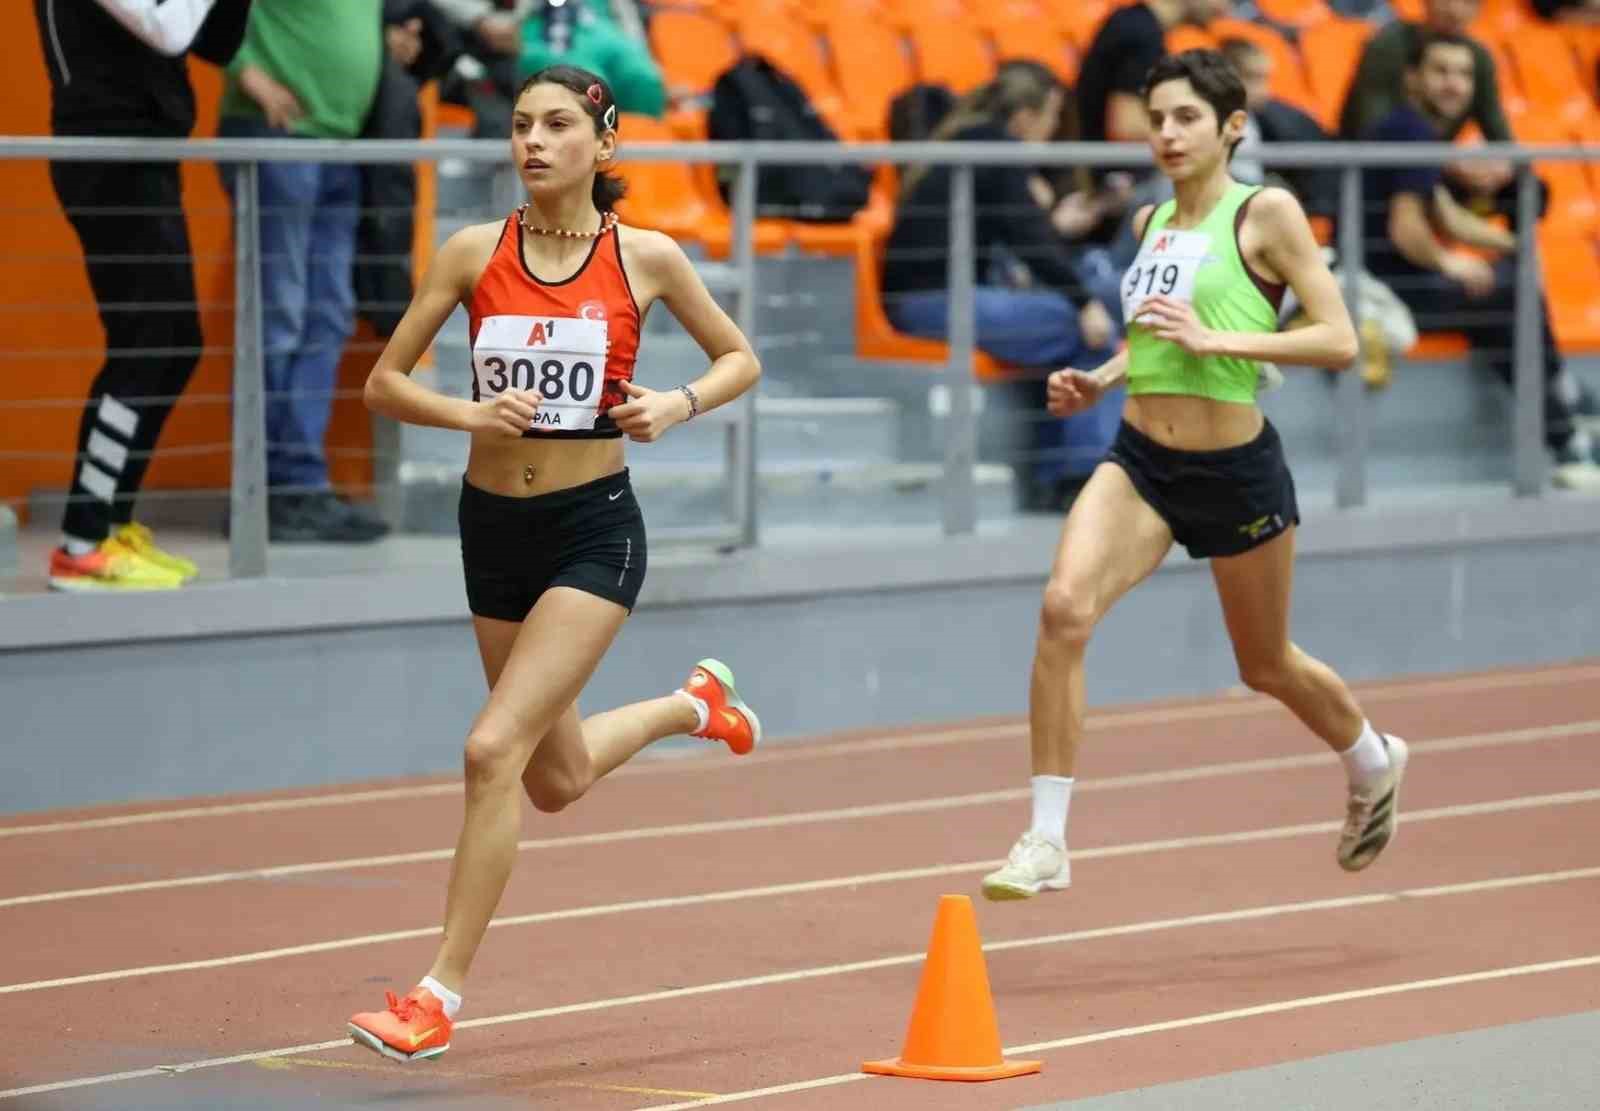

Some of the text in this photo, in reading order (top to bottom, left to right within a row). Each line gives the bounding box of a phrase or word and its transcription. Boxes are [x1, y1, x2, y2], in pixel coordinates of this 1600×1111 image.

[1127, 264, 1178, 297] 919
[527, 320, 554, 346] A1
[484, 357, 594, 402] 3080
